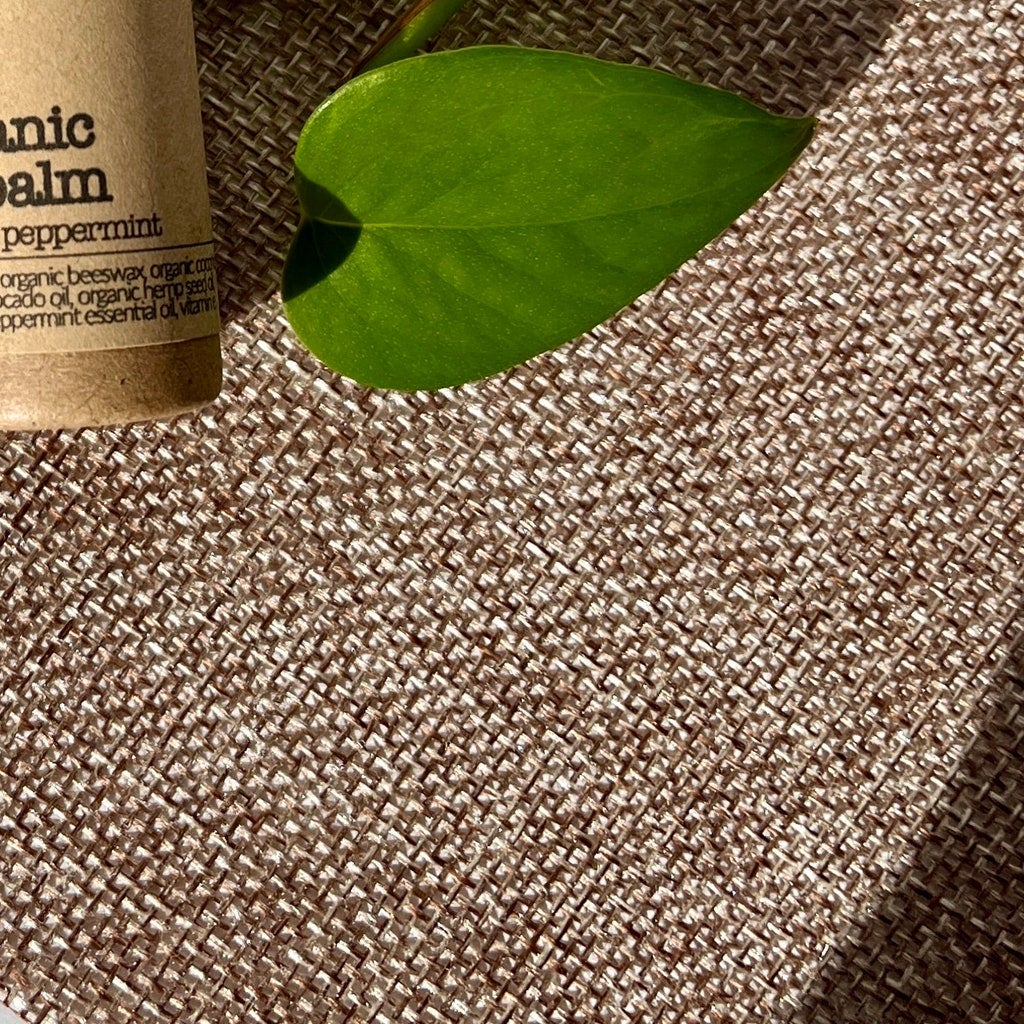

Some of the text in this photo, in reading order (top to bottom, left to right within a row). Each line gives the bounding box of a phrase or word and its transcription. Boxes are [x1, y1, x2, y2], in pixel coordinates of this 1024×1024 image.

[2, 212, 163, 252] peppermint
[0, 266, 65, 292] organic
[149, 256, 194, 282] organic
[49, 285, 74, 309] oil,
[77, 281, 140, 308] organic
[142, 276, 184, 301] hemp
[185, 273, 207, 296] seed
[84, 299, 157, 326] essential
[159, 298, 179, 320] oil,
